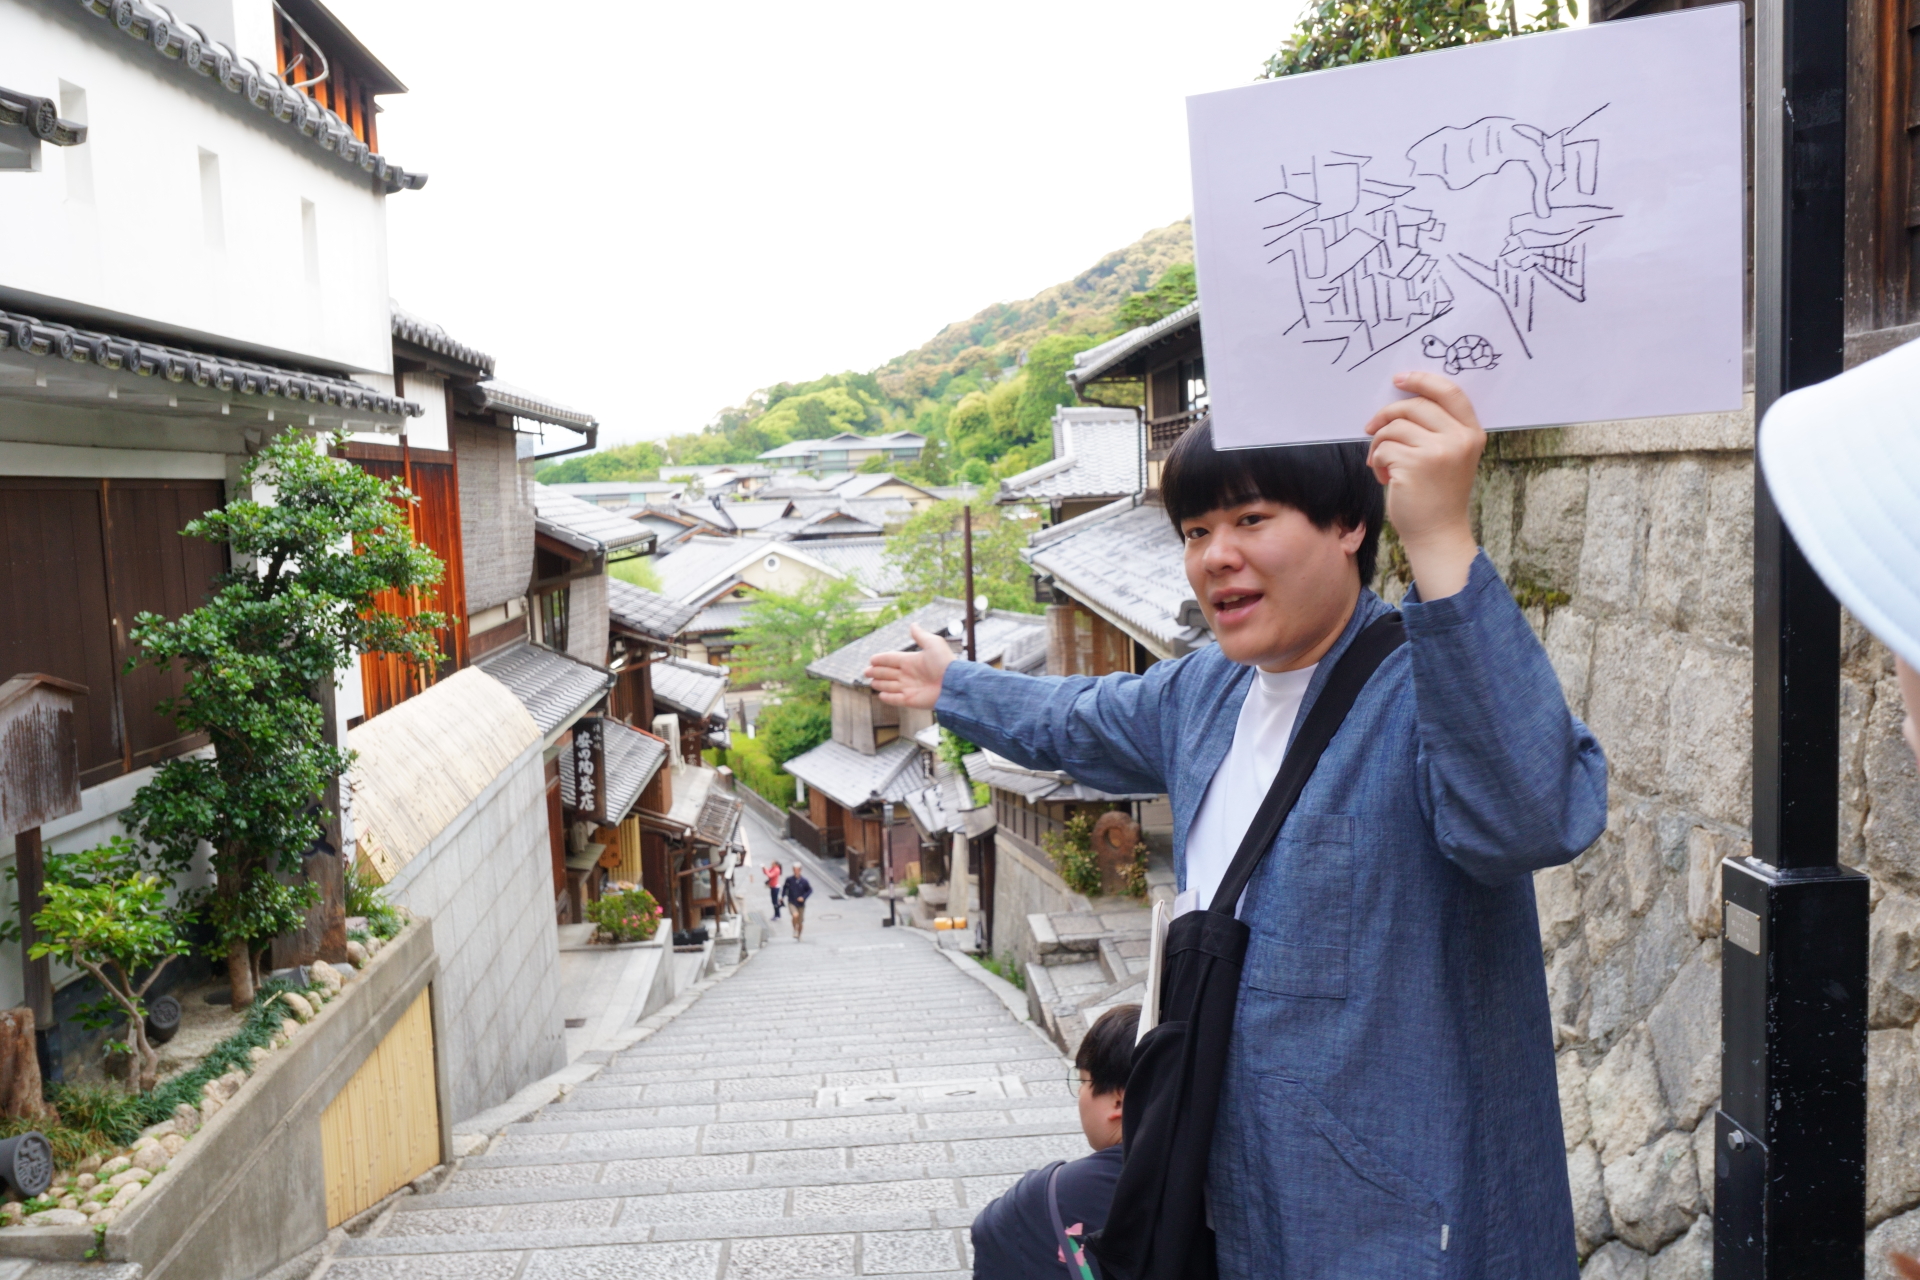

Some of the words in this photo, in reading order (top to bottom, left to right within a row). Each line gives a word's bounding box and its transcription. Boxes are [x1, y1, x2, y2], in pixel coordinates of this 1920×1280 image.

[575, 730, 596, 811] 安田陶器店
